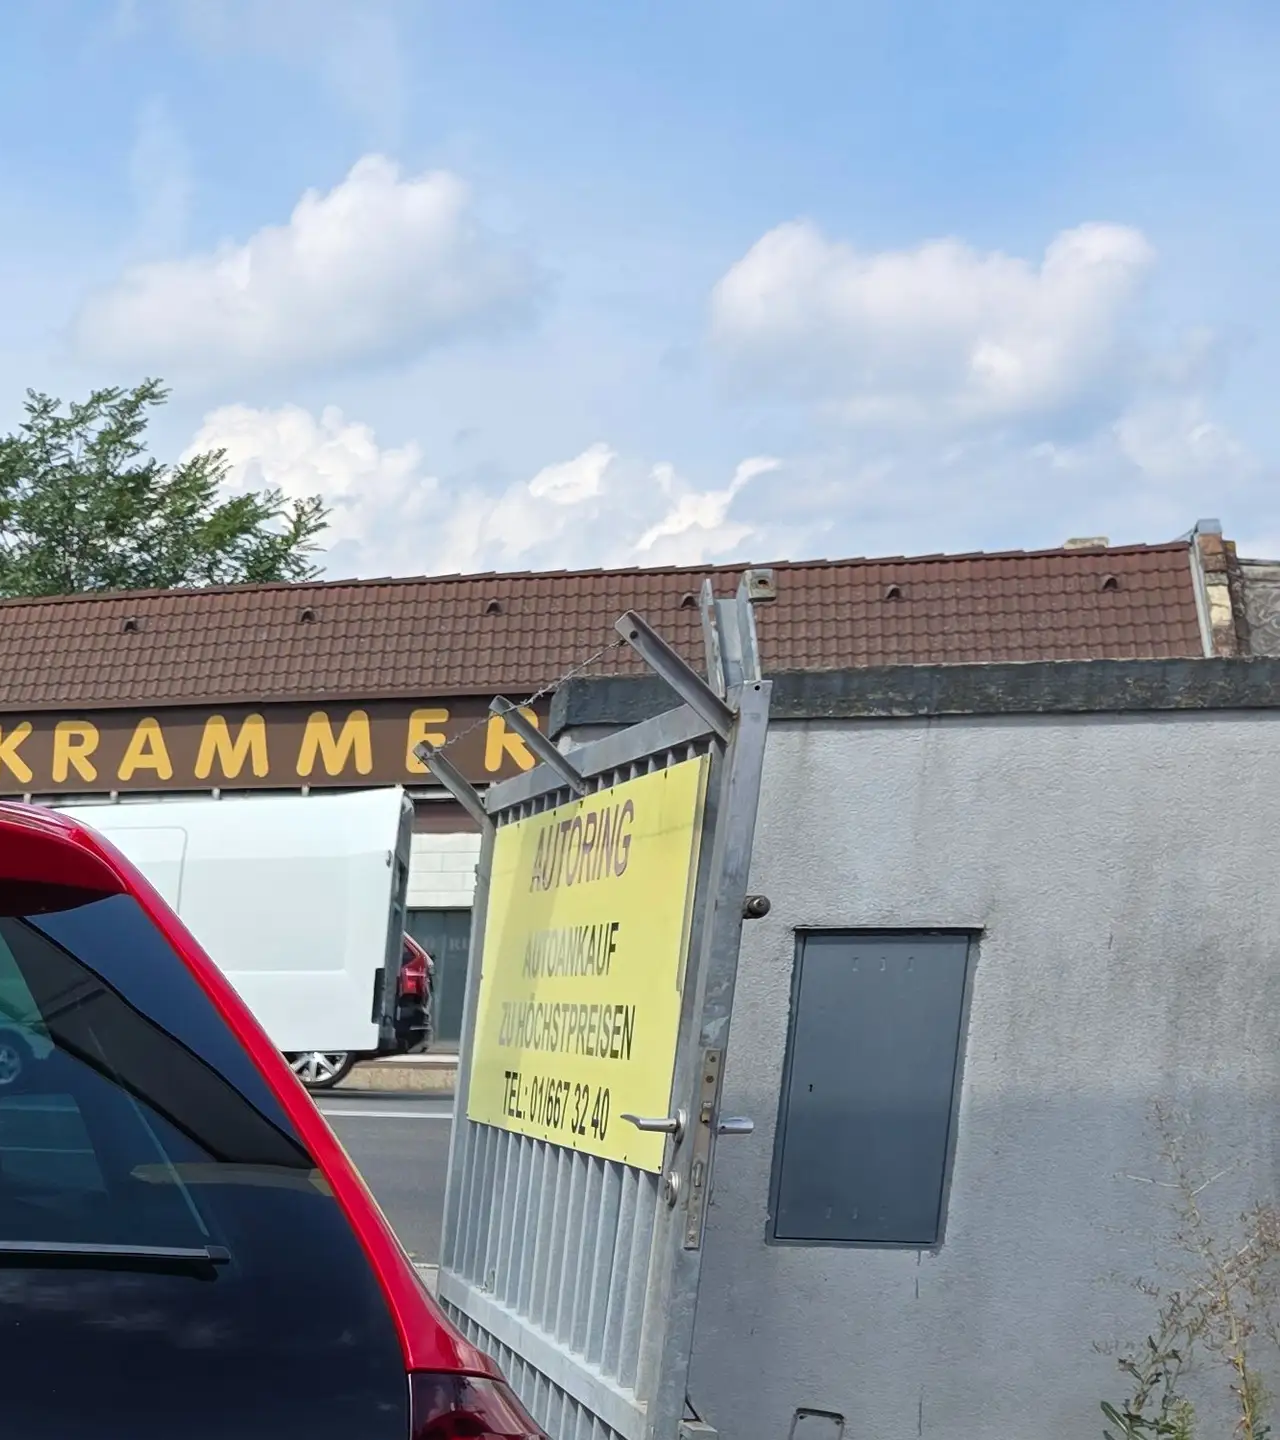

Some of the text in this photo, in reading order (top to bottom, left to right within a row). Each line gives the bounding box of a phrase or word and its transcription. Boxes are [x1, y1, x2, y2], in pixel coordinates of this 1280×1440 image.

[529, 799, 635, 893] AUTORING
[522, 921, 620, 978] AUTOANKAUF
[498, 992, 635, 1060] ZU HÖCHSTPREISEN
[530, 1075, 571, 1130] 01/667
[571, 1083, 589, 1136] 32
[591, 1086, 610, 1141] 40
